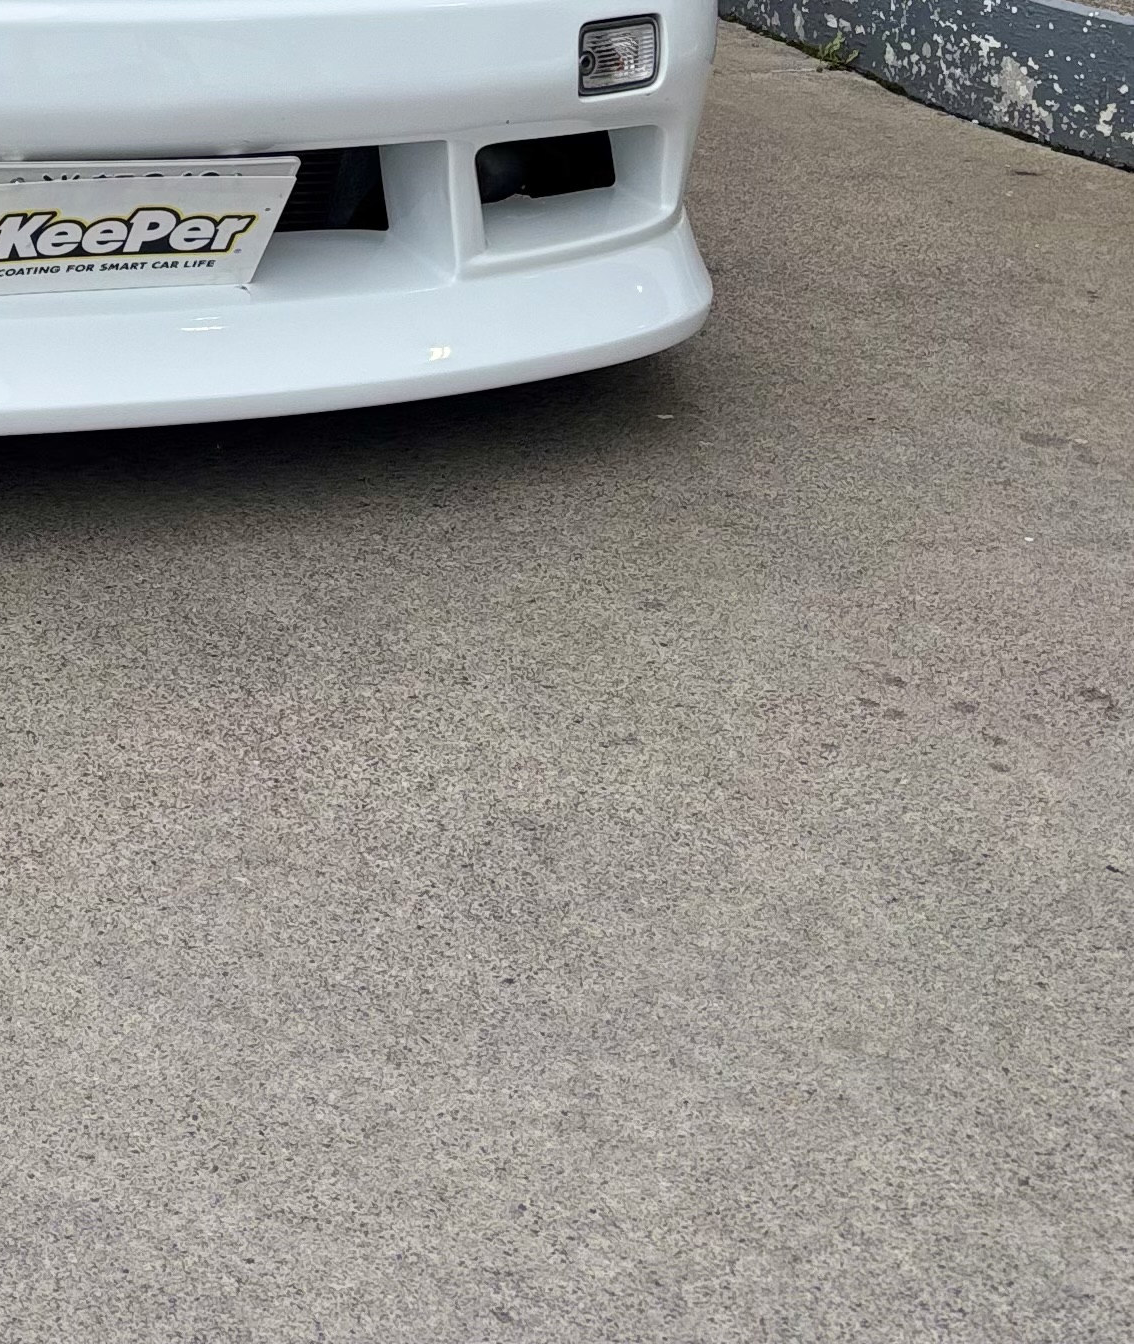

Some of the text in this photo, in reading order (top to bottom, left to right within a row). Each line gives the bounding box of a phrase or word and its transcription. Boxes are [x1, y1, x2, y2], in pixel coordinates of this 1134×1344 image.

[66, 264, 94, 273] FOR
[99, 262, 146, 271] SMART
[152, 261, 178, 270] CAR
[184, 259, 216, 268] LIFE
